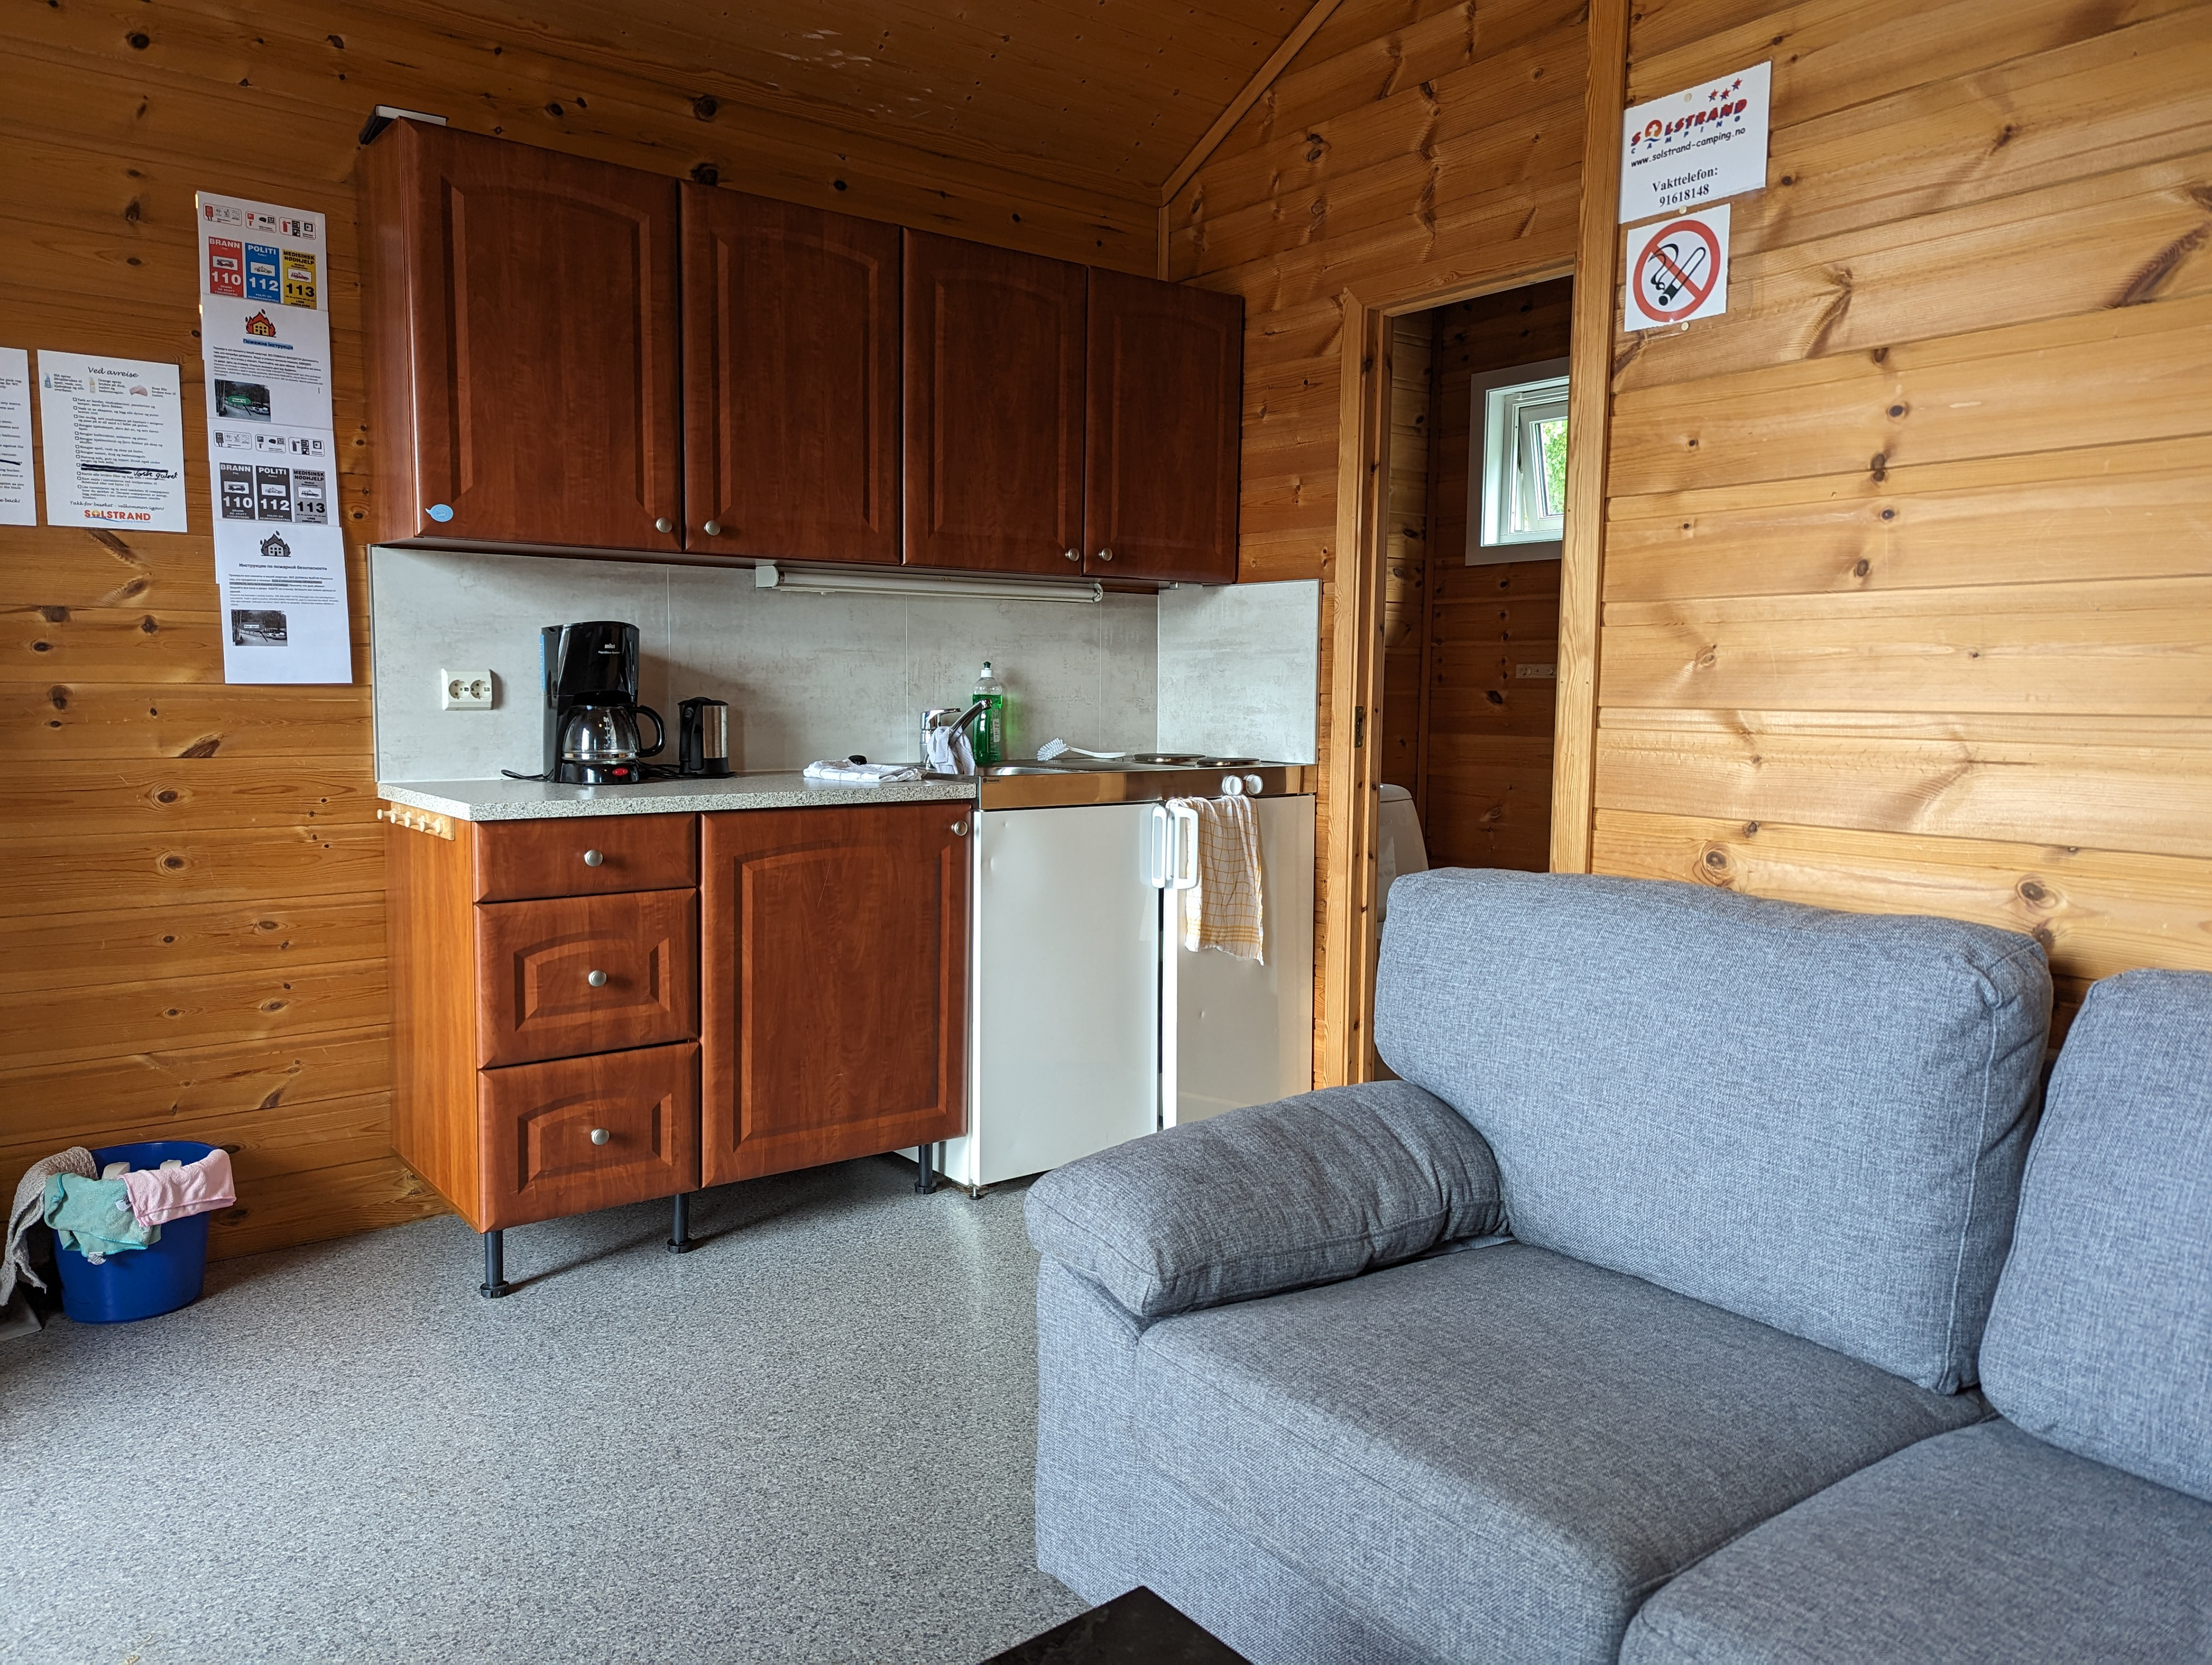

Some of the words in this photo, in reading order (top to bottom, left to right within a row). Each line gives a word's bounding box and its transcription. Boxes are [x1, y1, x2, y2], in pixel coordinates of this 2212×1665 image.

[1630, 98, 1747, 147] SOLSTRAND
[1631, 127, 1746, 168] www.solstrand-camping.no
[1652, 167, 1718, 192] Vakttelefon:
[1660, 184, 1709, 208] 91618148
[209, 238, 240, 249] BRANN
[248, 245, 276, 255] POLITI
[283, 251, 315, 260] MEDISINSK
[284, 256, 315, 265] NØDHJELP
[211, 271, 241, 286] 110
[249, 277, 279, 291] 112
[286, 283, 315, 298] 113
[107, 370, 139, 378] avreise
[220, 464, 251, 472] BRANN
[259, 467, 287, 475] POLITI
[223, 496, 253, 509] 110
[260, 498, 290, 511] 112
[297, 501, 325, 513] 113
[84, 509, 151, 521] SOLSTRAND
